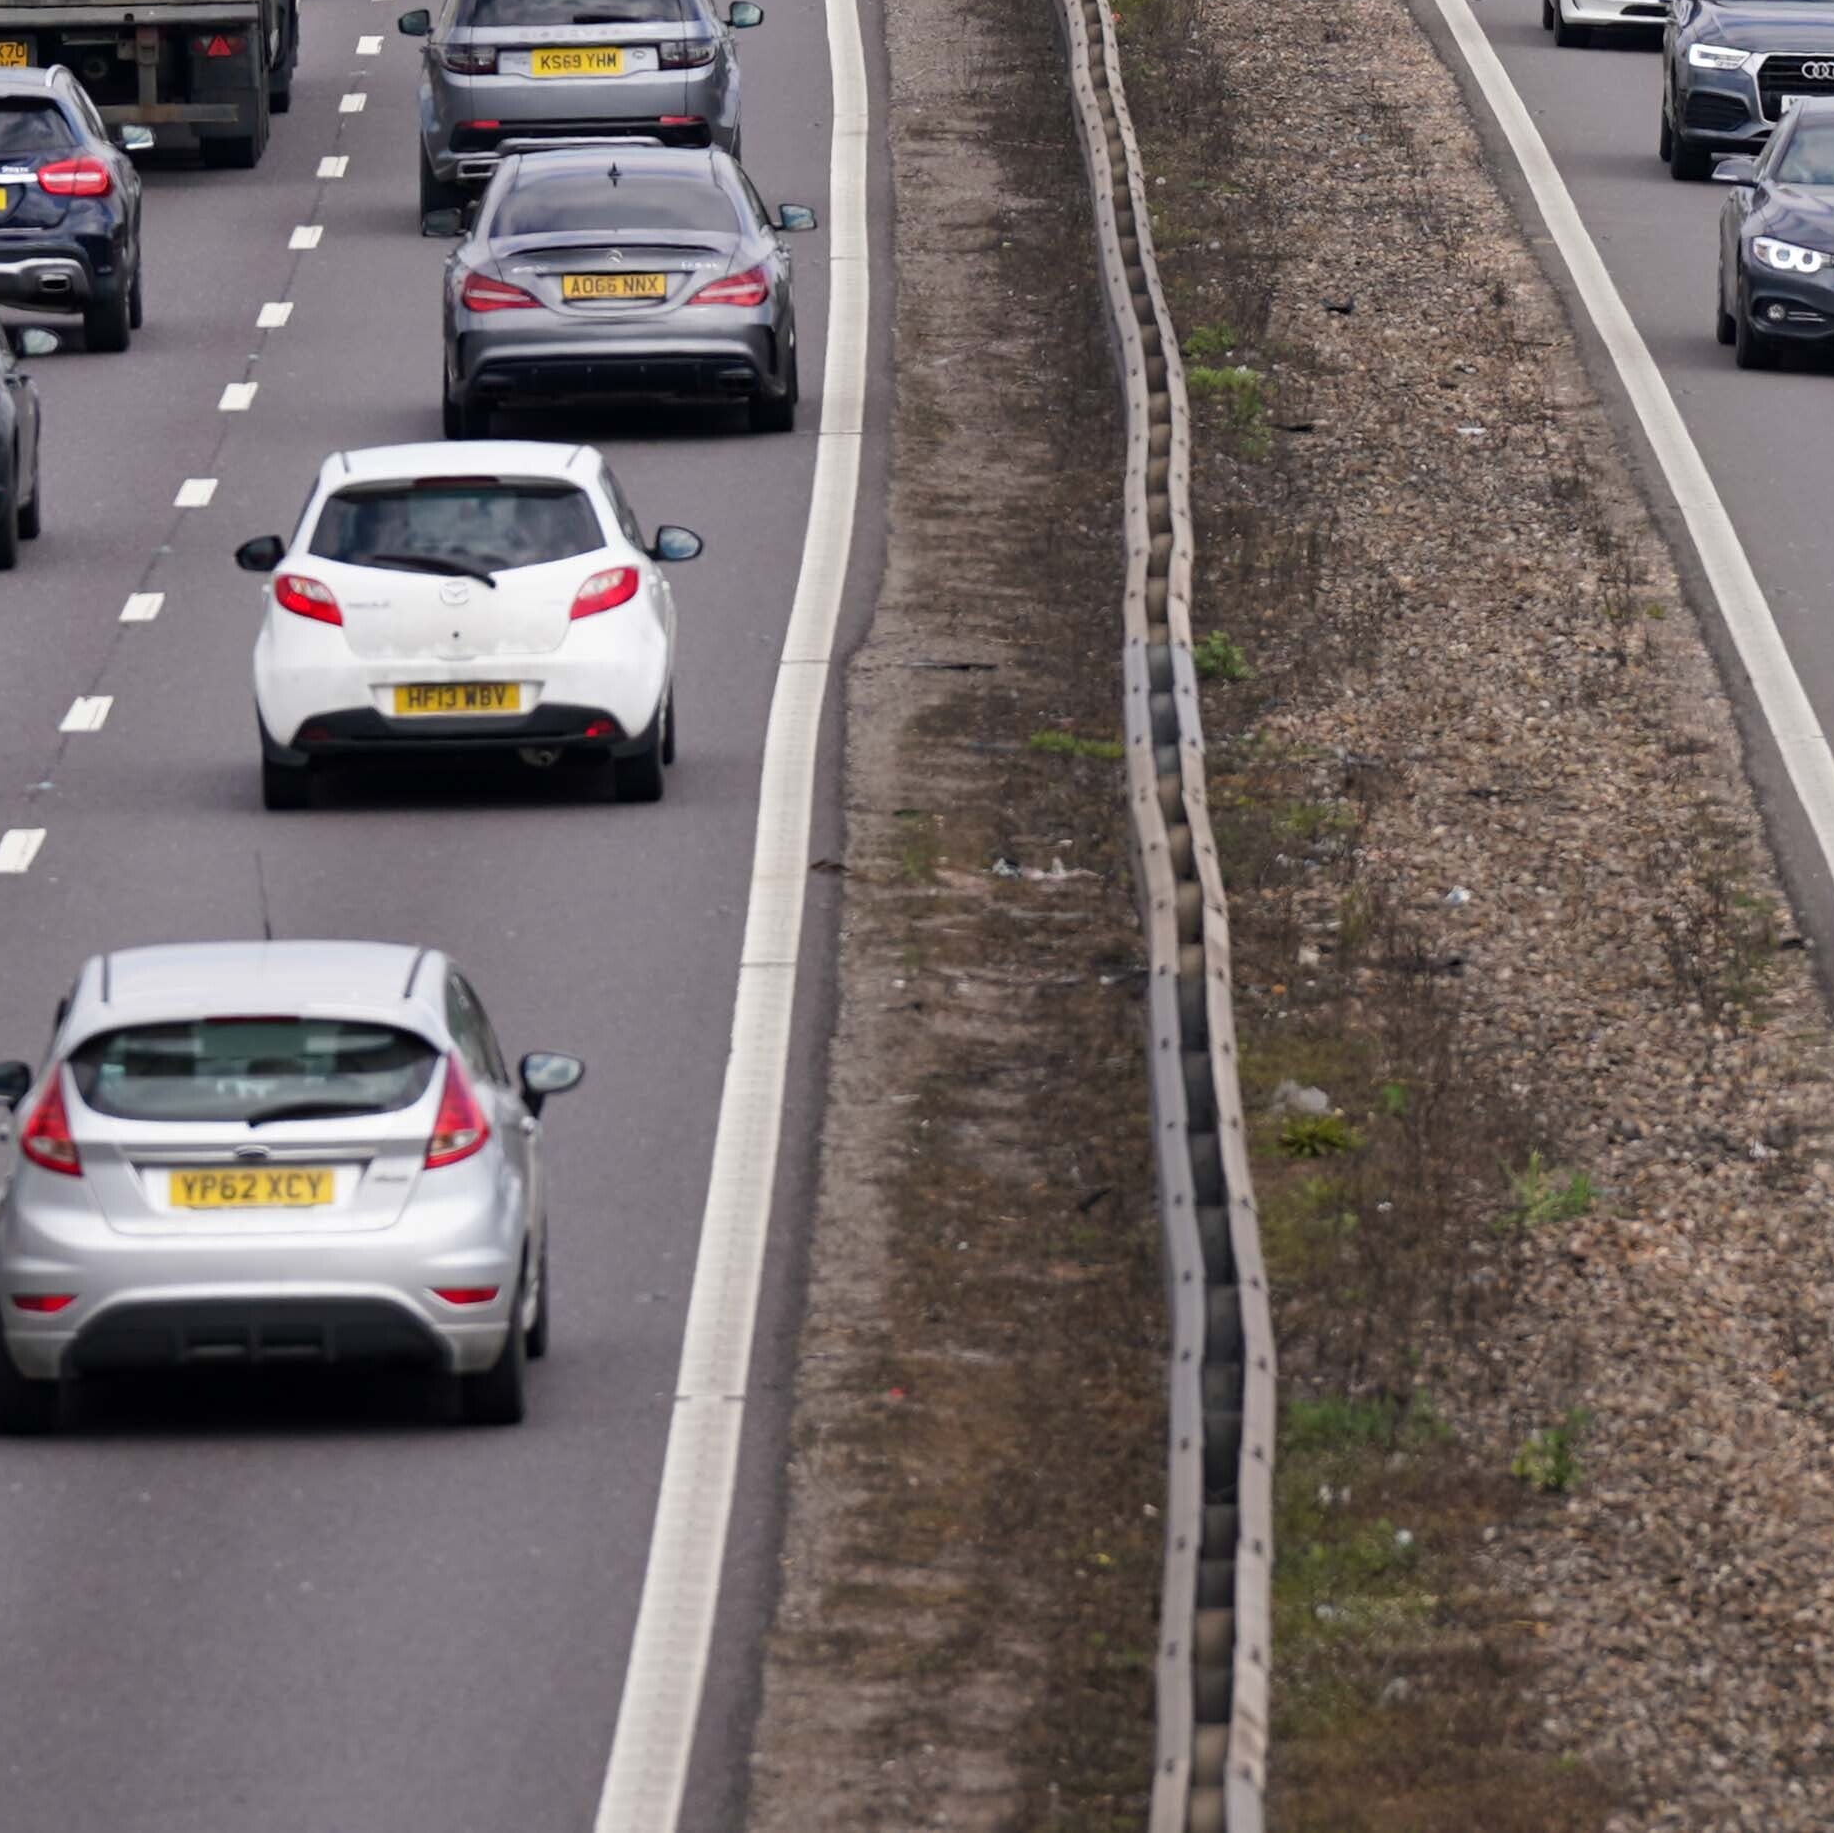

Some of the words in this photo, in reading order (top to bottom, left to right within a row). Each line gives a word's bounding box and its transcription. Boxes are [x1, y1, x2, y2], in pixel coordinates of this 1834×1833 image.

[540, 55, 582, 70] KS69
[588, 54, 618, 69] YHM
[570, 278, 618, 294] AO66
[622, 277, 659, 293] NNX
[407, 685, 458, 710] HF13
[464, 684, 508, 708] WBV
[182, 1170, 258, 1201] YP62
[267, 1168, 324, 1199] XCY
